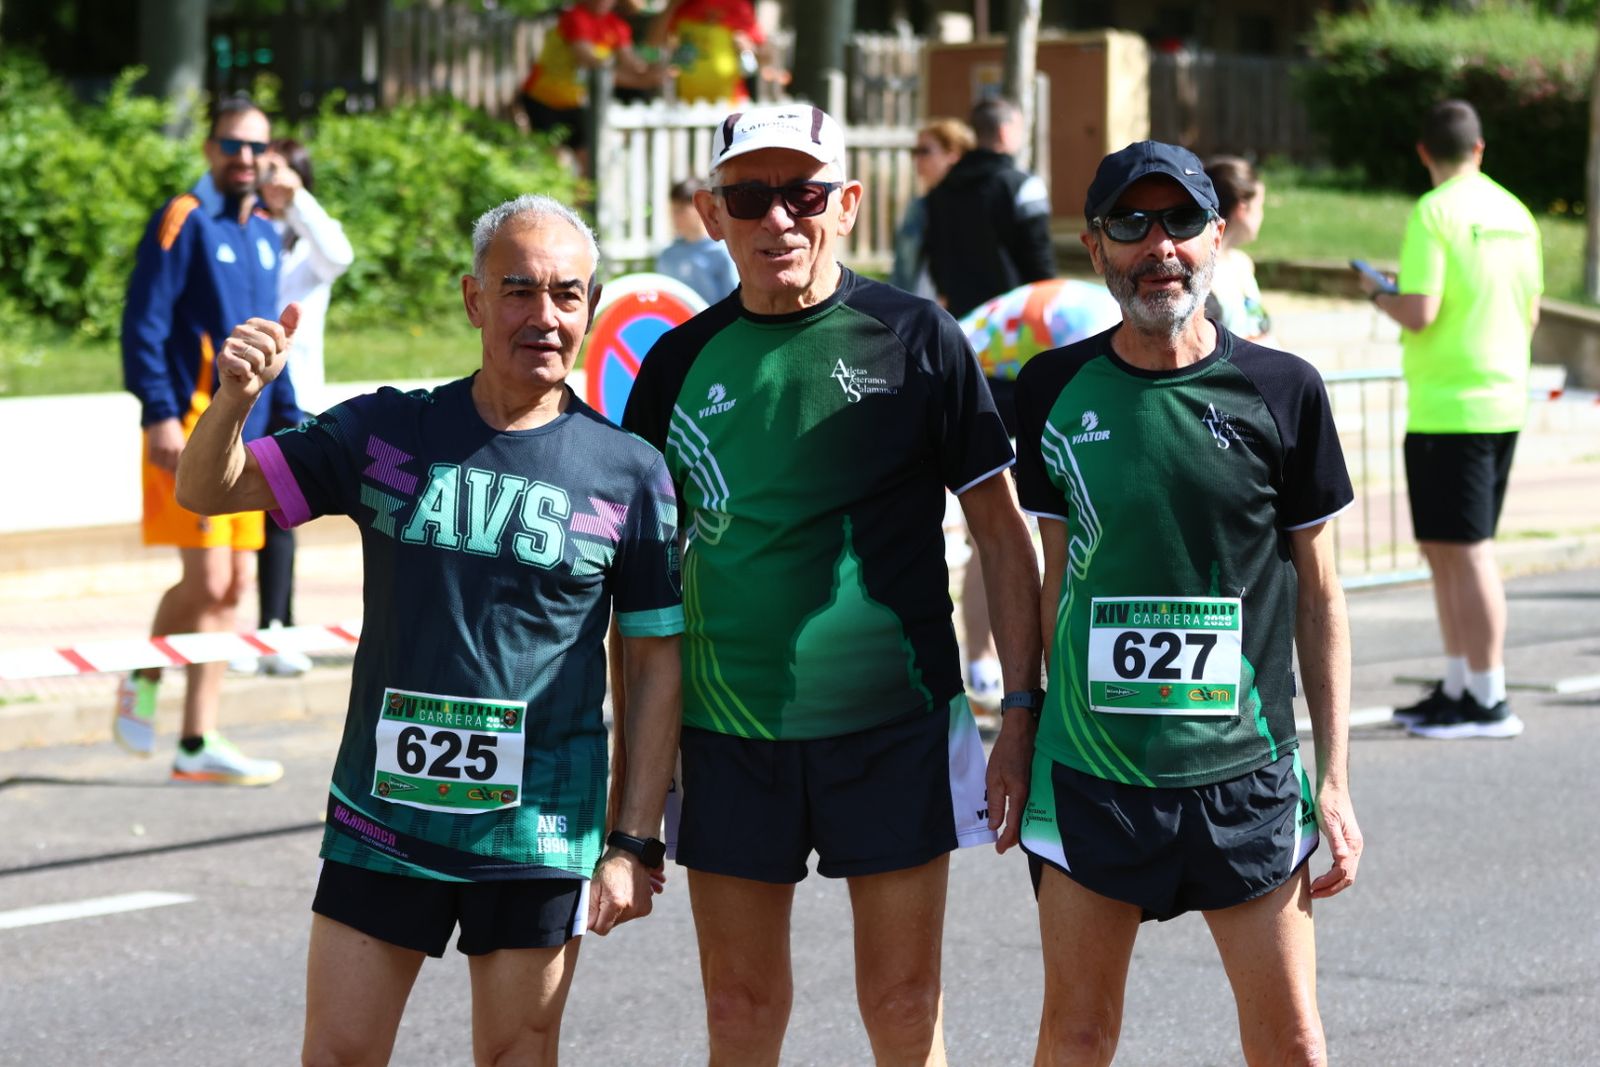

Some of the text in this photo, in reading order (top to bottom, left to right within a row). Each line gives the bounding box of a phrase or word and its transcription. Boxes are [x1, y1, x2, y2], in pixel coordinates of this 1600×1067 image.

[1072, 429, 1111, 445] VIATOR
[401, 462, 570, 570] AVS
[1095, 603, 1235, 624] XIV SAN FERNANDO
[1133, 614, 1200, 625] CARRERA
[1113, 631, 1218, 680] 627
[421, 700, 441, 712] SAN
[419, 709, 482, 728] CARRERA
[397, 726, 498, 781] 625
[536, 814, 568, 833] AVS
[536, 837, 569, 854] 1990
